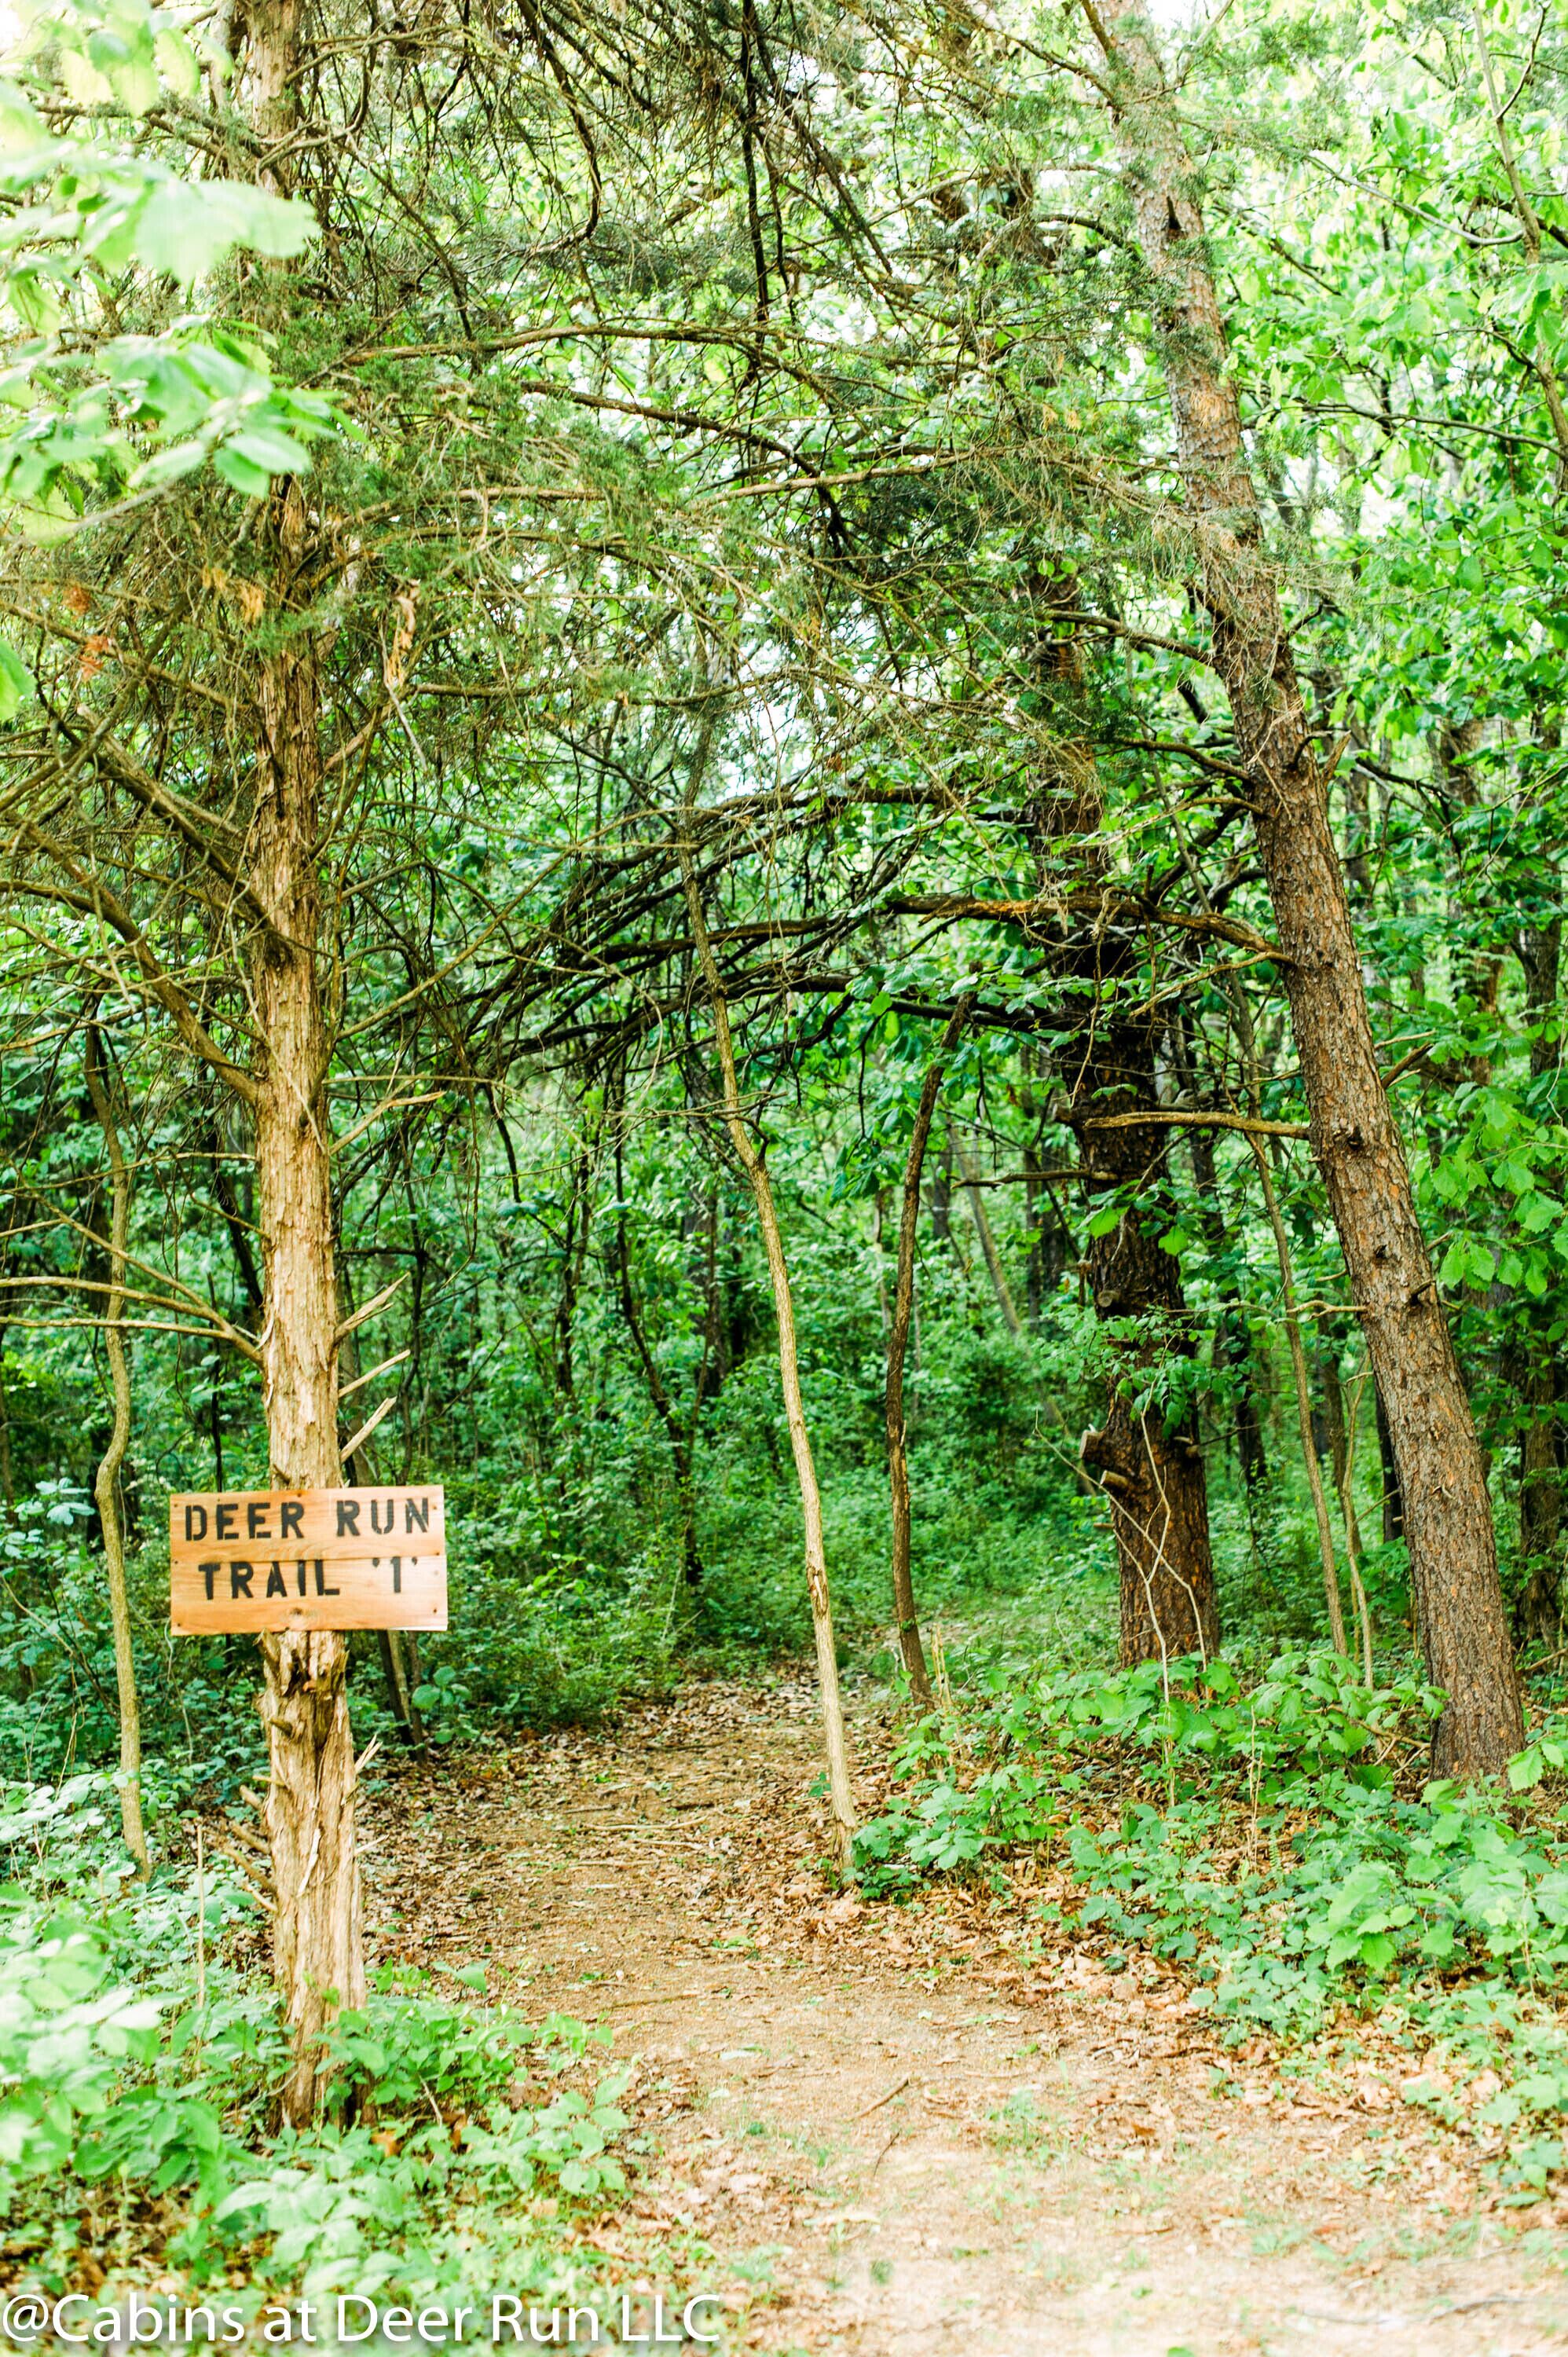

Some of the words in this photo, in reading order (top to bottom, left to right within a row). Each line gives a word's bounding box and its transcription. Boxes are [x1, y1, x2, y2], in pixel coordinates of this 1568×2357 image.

[185, 1501, 305, 1541] DEER
[336, 1497, 430, 1537] RUN
[198, 1559, 340, 1600] TRAIL
